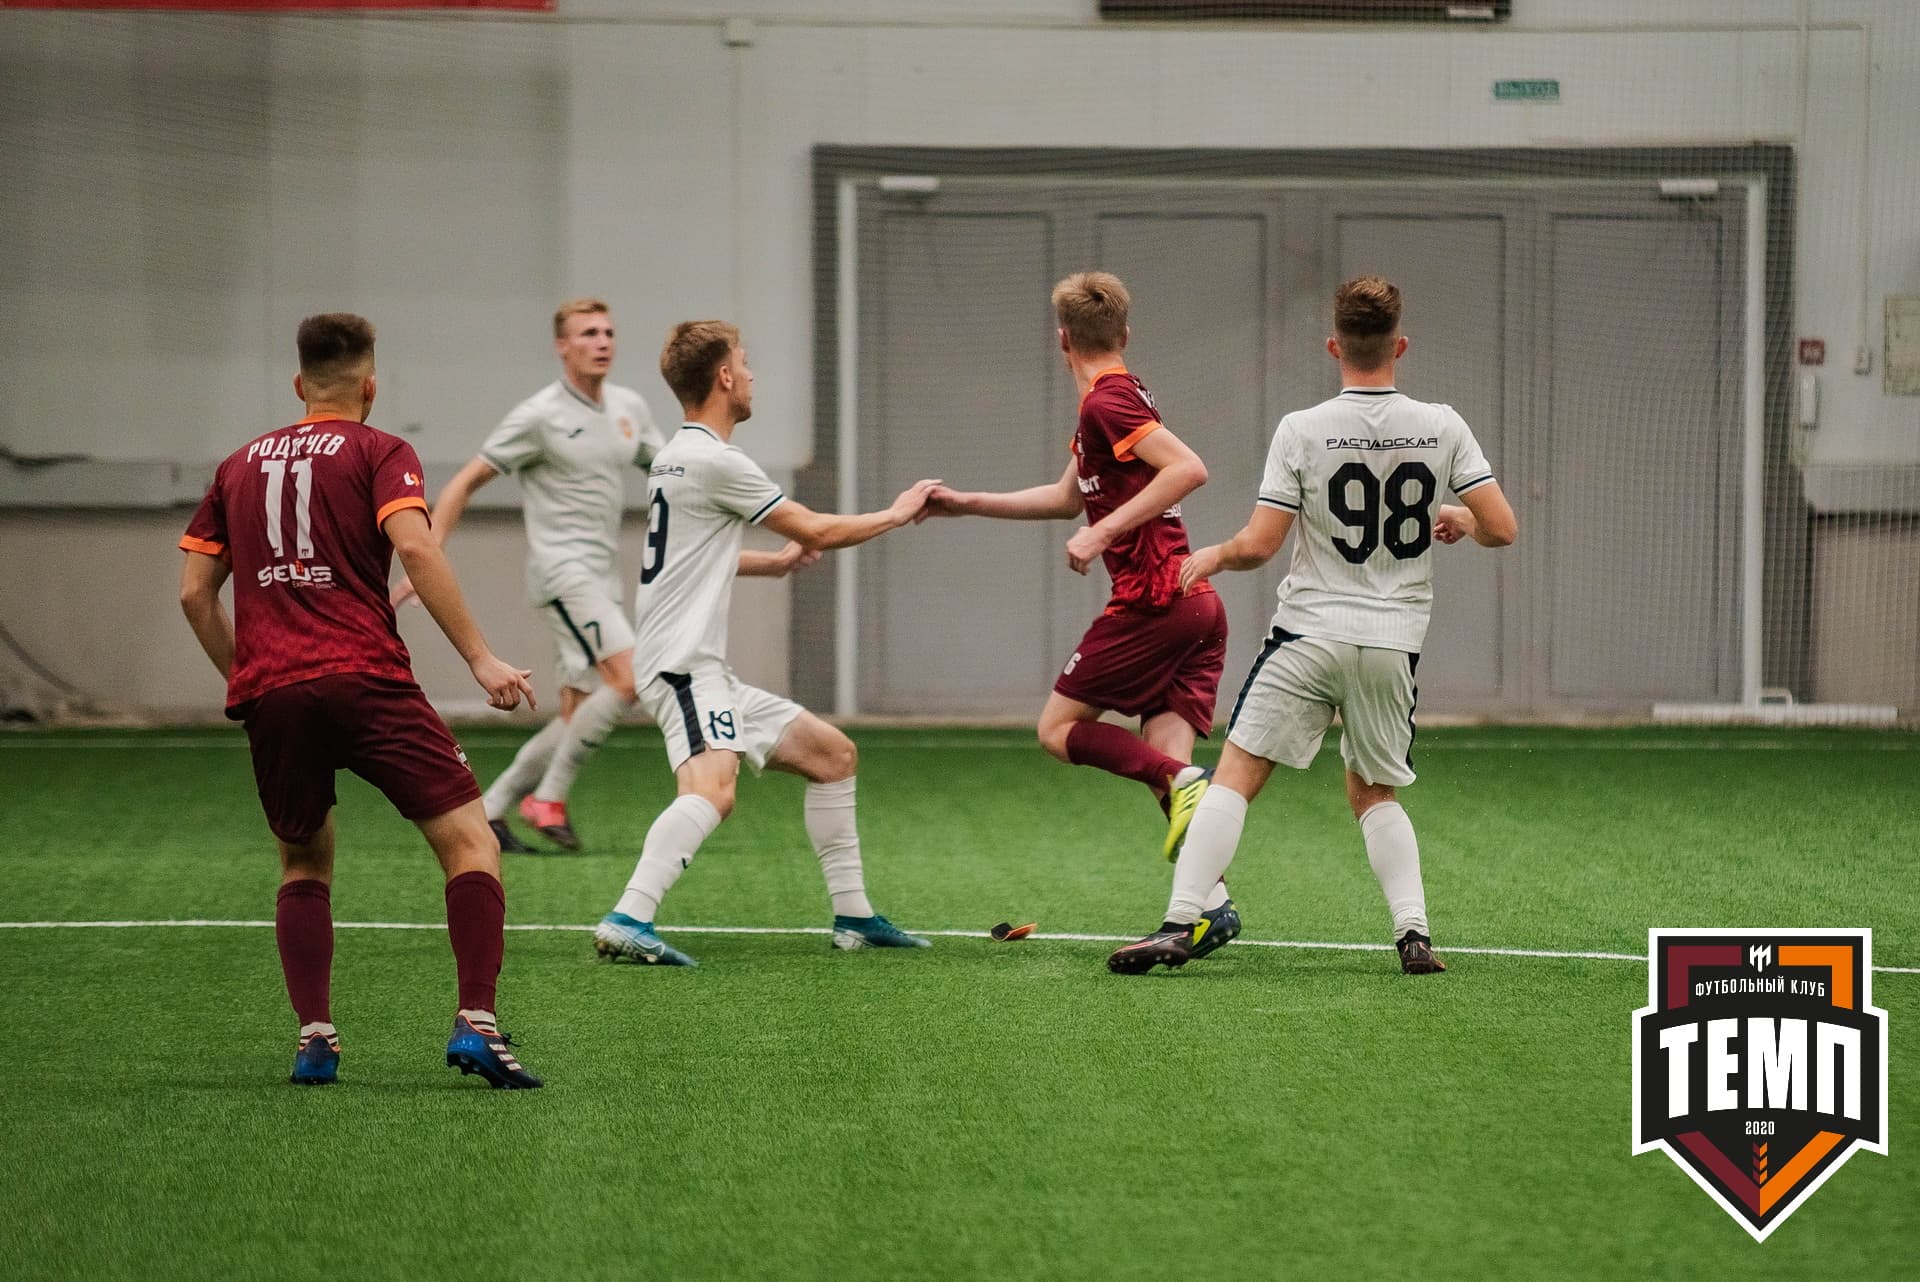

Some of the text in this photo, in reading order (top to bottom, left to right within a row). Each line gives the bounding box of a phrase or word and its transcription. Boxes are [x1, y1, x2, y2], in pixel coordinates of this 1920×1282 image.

[260, 457, 314, 559] 11
[1328, 462, 1437, 564] 98
[584, 620, 602, 649] 7
[709, 710, 736, 740] 19
